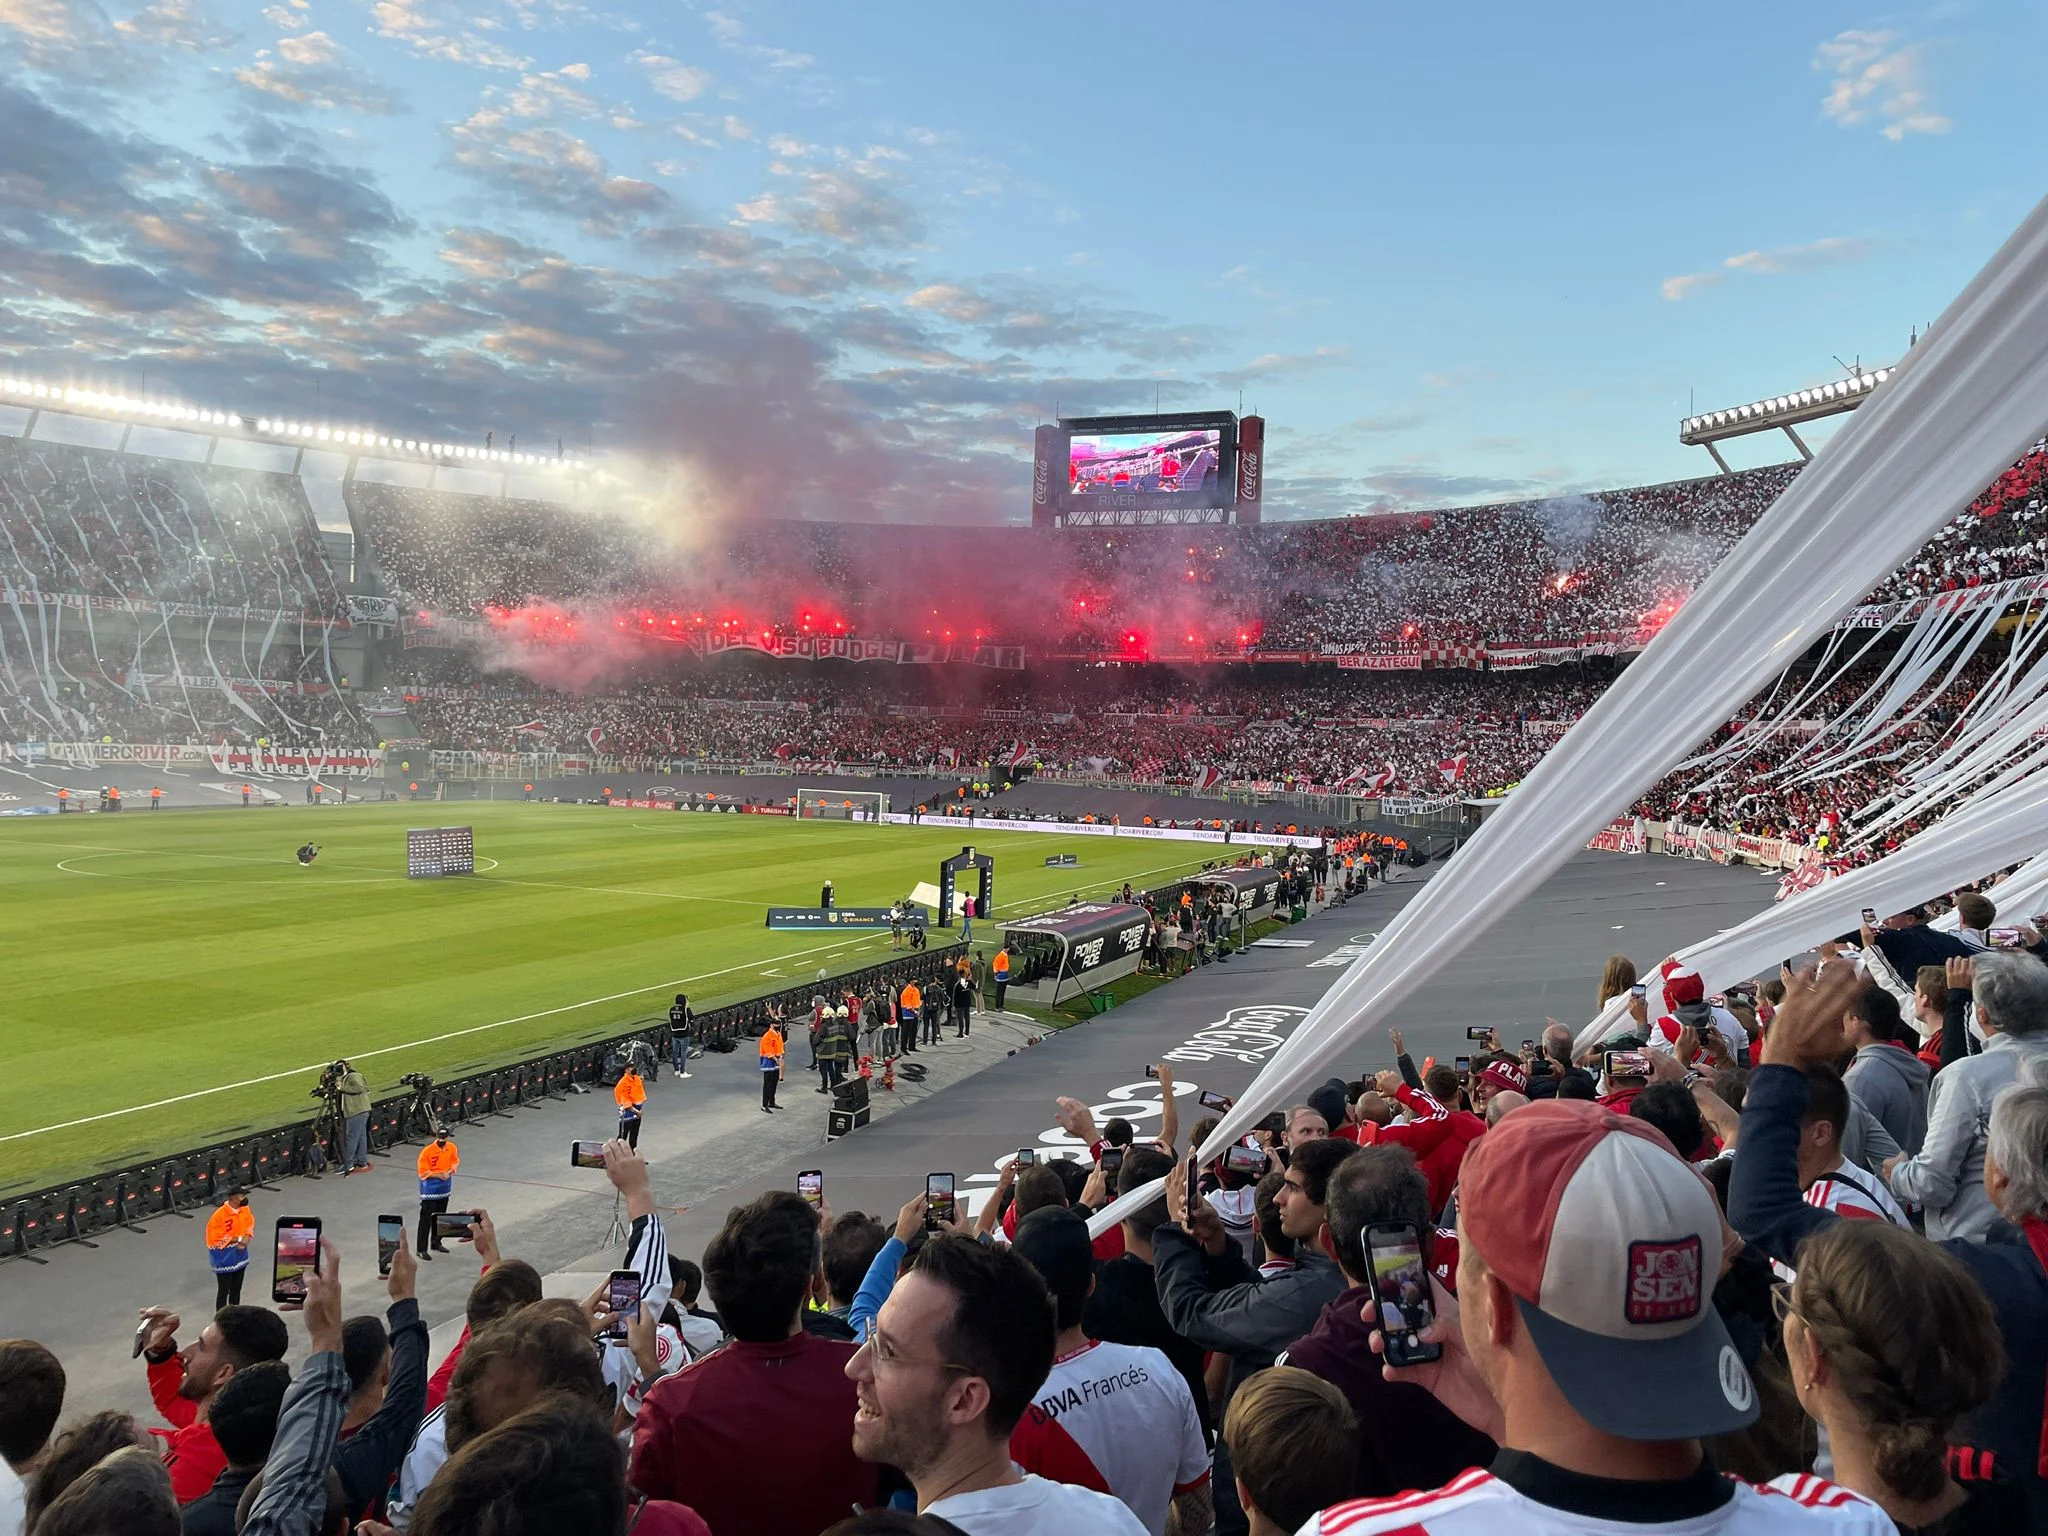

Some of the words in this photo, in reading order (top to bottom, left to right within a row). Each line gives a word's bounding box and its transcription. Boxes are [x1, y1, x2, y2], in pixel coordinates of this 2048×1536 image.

[1033, 457, 1048, 504] Coca-Cola
[1241, 450, 1258, 500] Coca-Cola
[1099, 495, 1136, 506] RIVER
[761, 635, 813, 656] VISO
[817, 638, 896, 660] BUDGE
[1371, 642, 1420, 655] SOLANO
[1339, 655, 1420, 669] BERAZATEGUI
[760, 807, 781, 815] TURKISH
[1055, 824, 1105, 833] TIENDARIVER.COM
[1119, 923, 1145, 944] POWER
[1073, 937, 1104, 960] POWER
[1125, 936, 1142, 953] ADE
[1081, 952, 1101, 969] ADE
[1635, 1246, 1698, 1277] JON
[1632, 1272, 1698, 1302] SEN
[1029, 1387, 1082, 1425] BBVA
[1082, 1364, 1149, 1402] Francés
